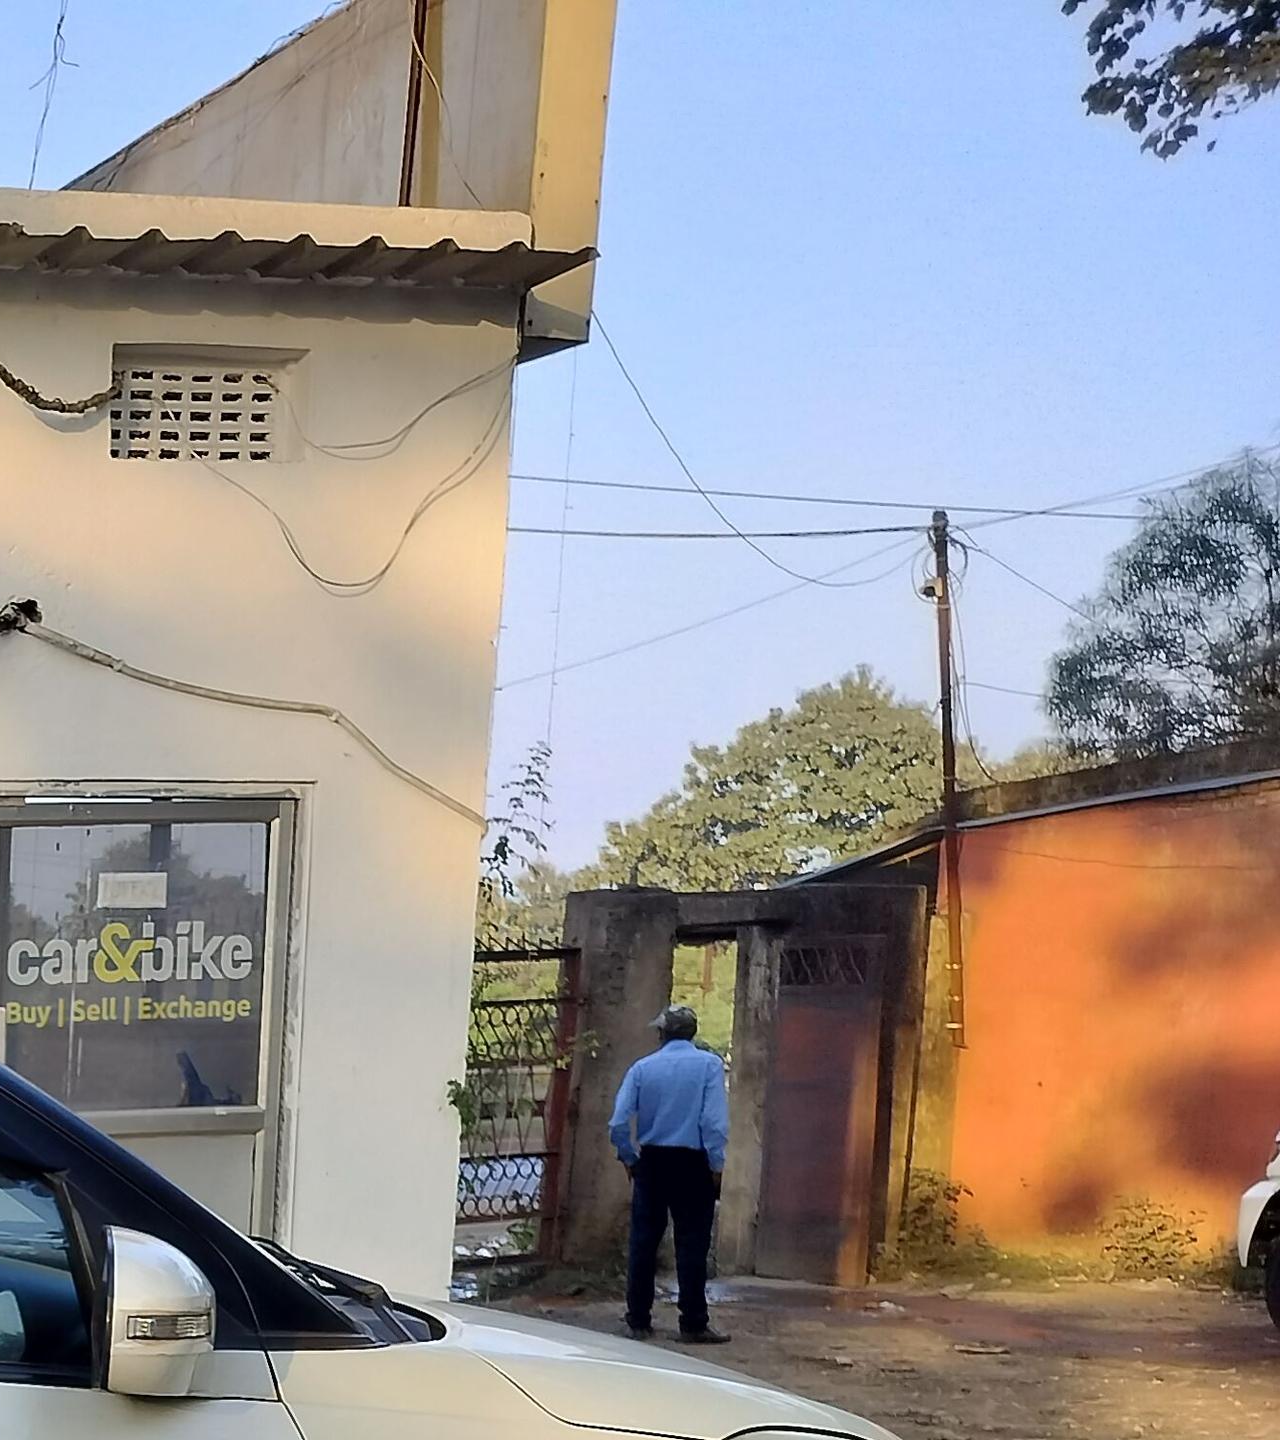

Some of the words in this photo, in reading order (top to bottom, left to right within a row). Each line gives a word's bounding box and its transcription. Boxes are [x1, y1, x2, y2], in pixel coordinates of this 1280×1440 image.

[7, 920, 253, 986] car&bike
[5, 1002, 52, 1028] Buy
[71, 996, 118, 1023] Sell
[138, 995, 252, 1022] Exchange
